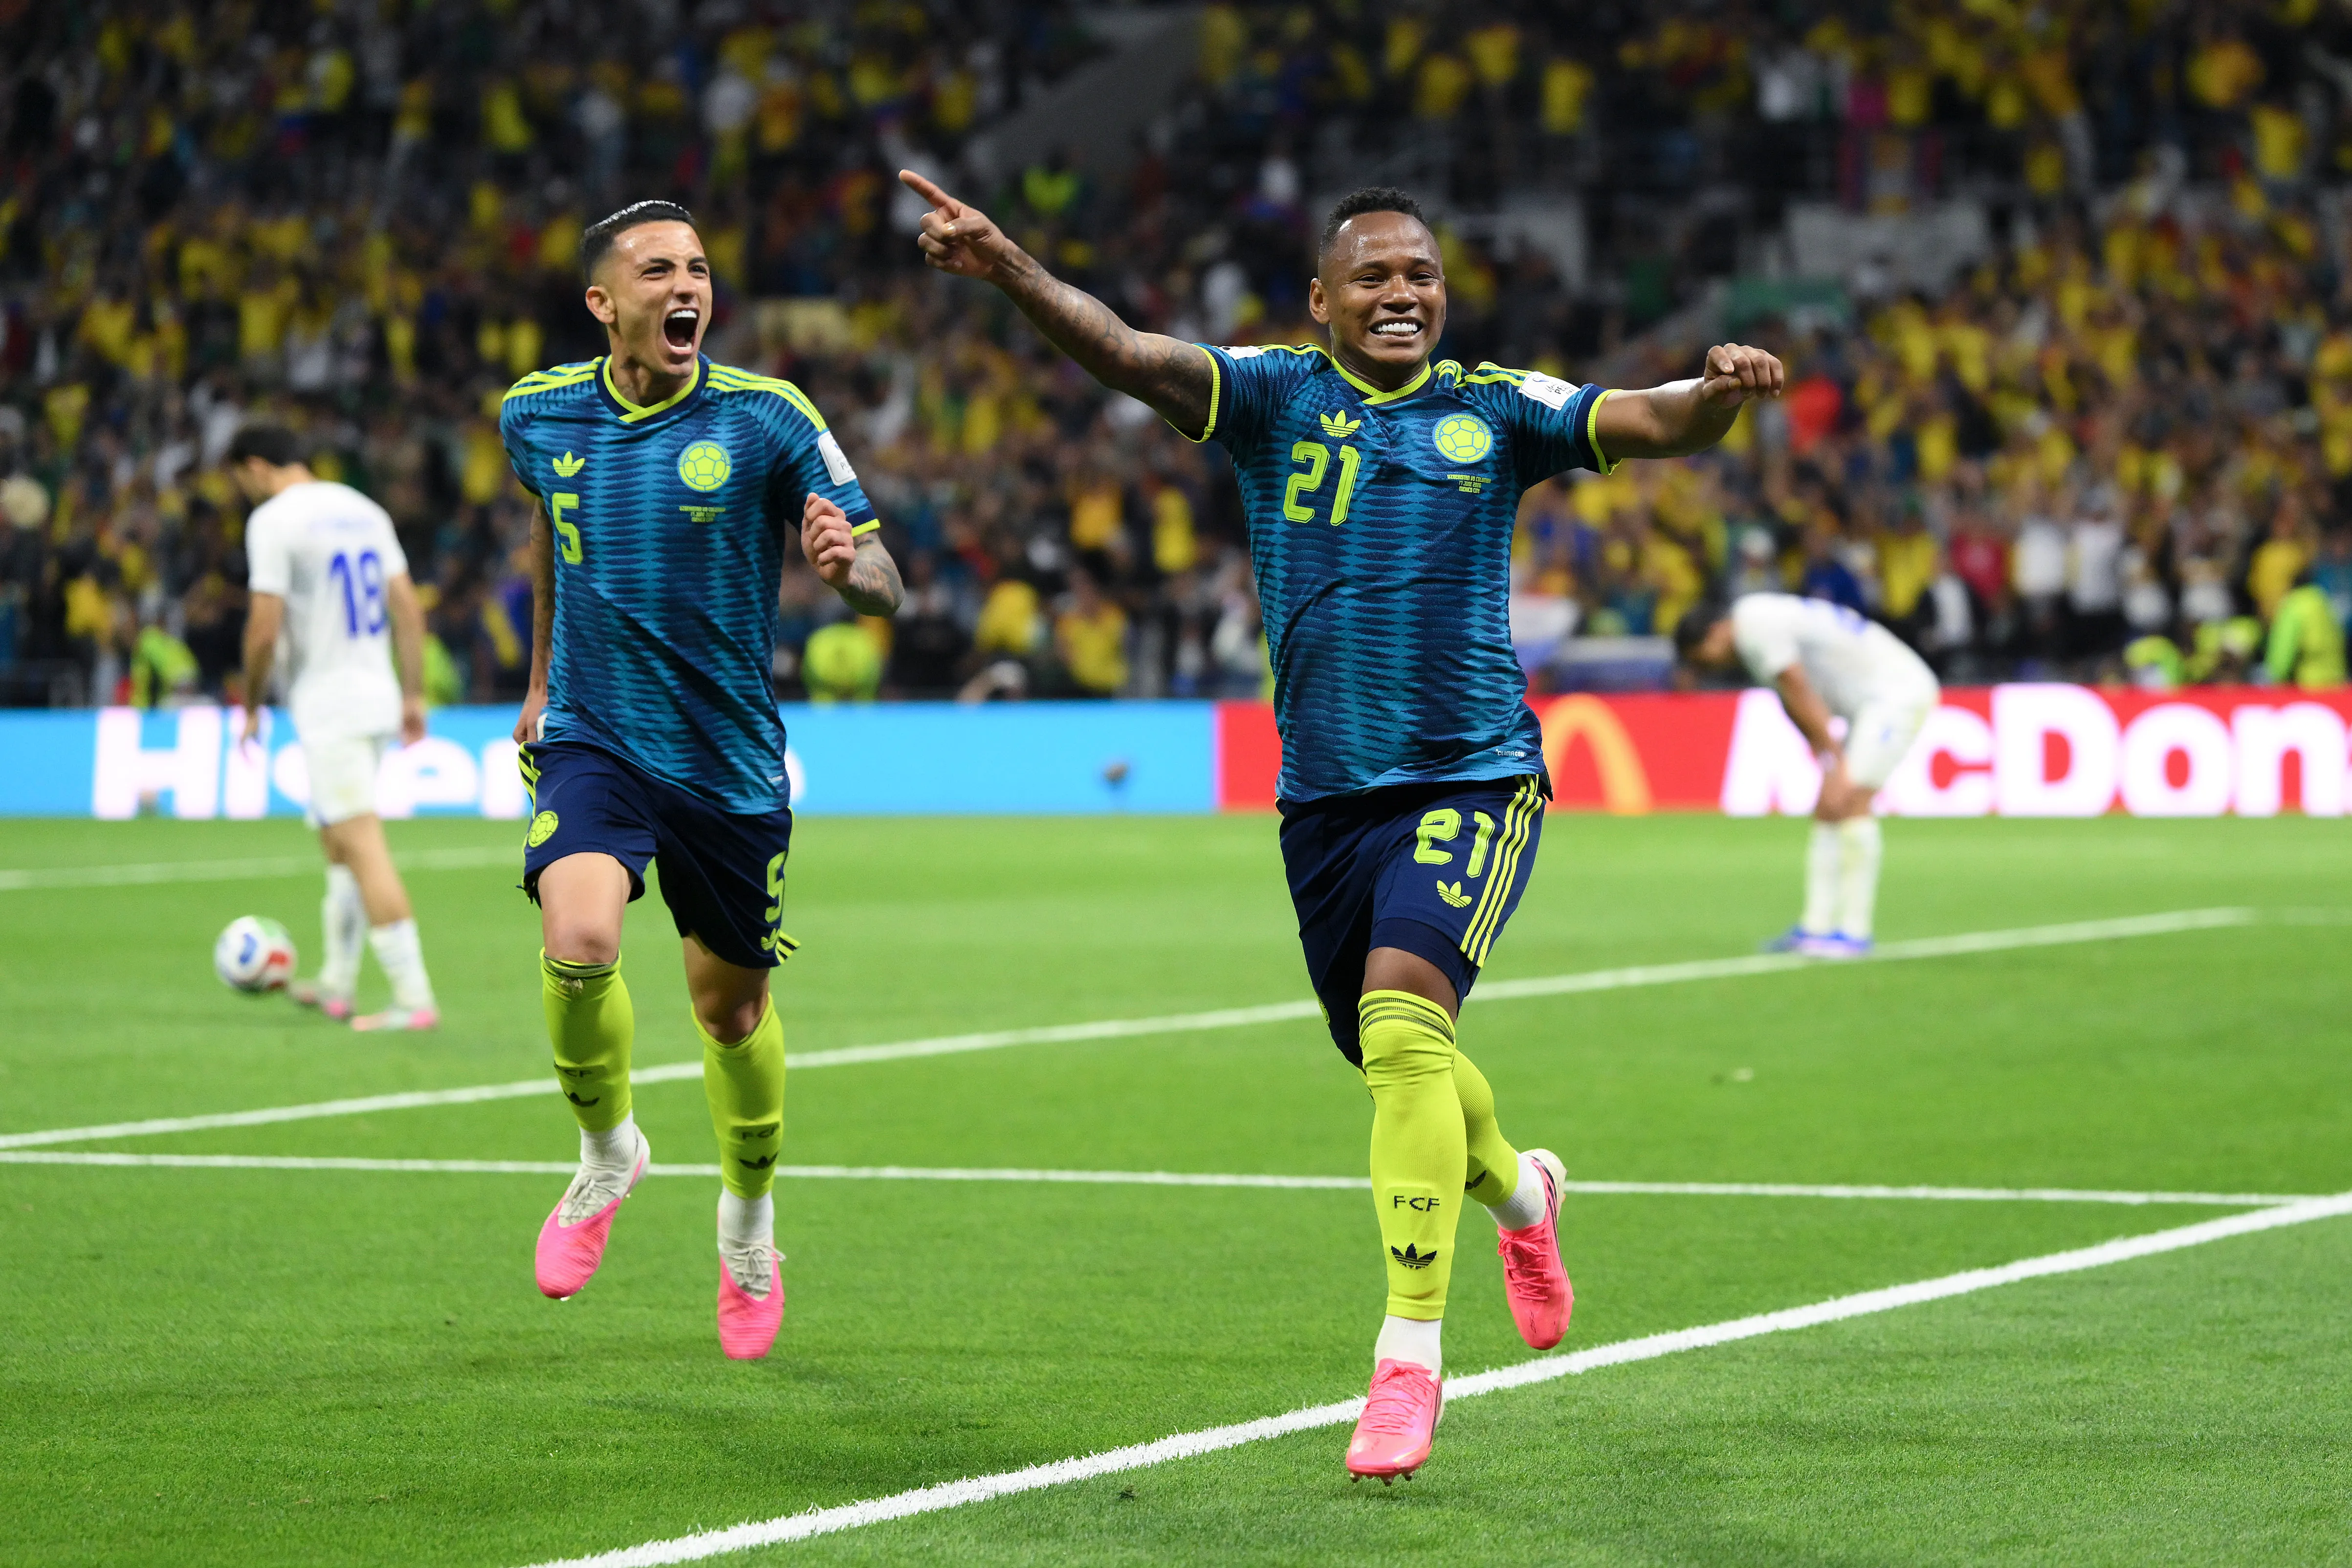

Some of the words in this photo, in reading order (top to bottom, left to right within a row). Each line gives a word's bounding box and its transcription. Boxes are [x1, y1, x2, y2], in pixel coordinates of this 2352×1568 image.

[1283, 441, 1362, 527] 21
[552, 492, 583, 566] 5
[329, 548, 386, 639] 18
[1720, 683, 2352, 817] McDon
[1413, 808, 1495, 878] 21
[765, 850, 787, 924] 5
[1394, 1195, 1440, 1212] FCF
